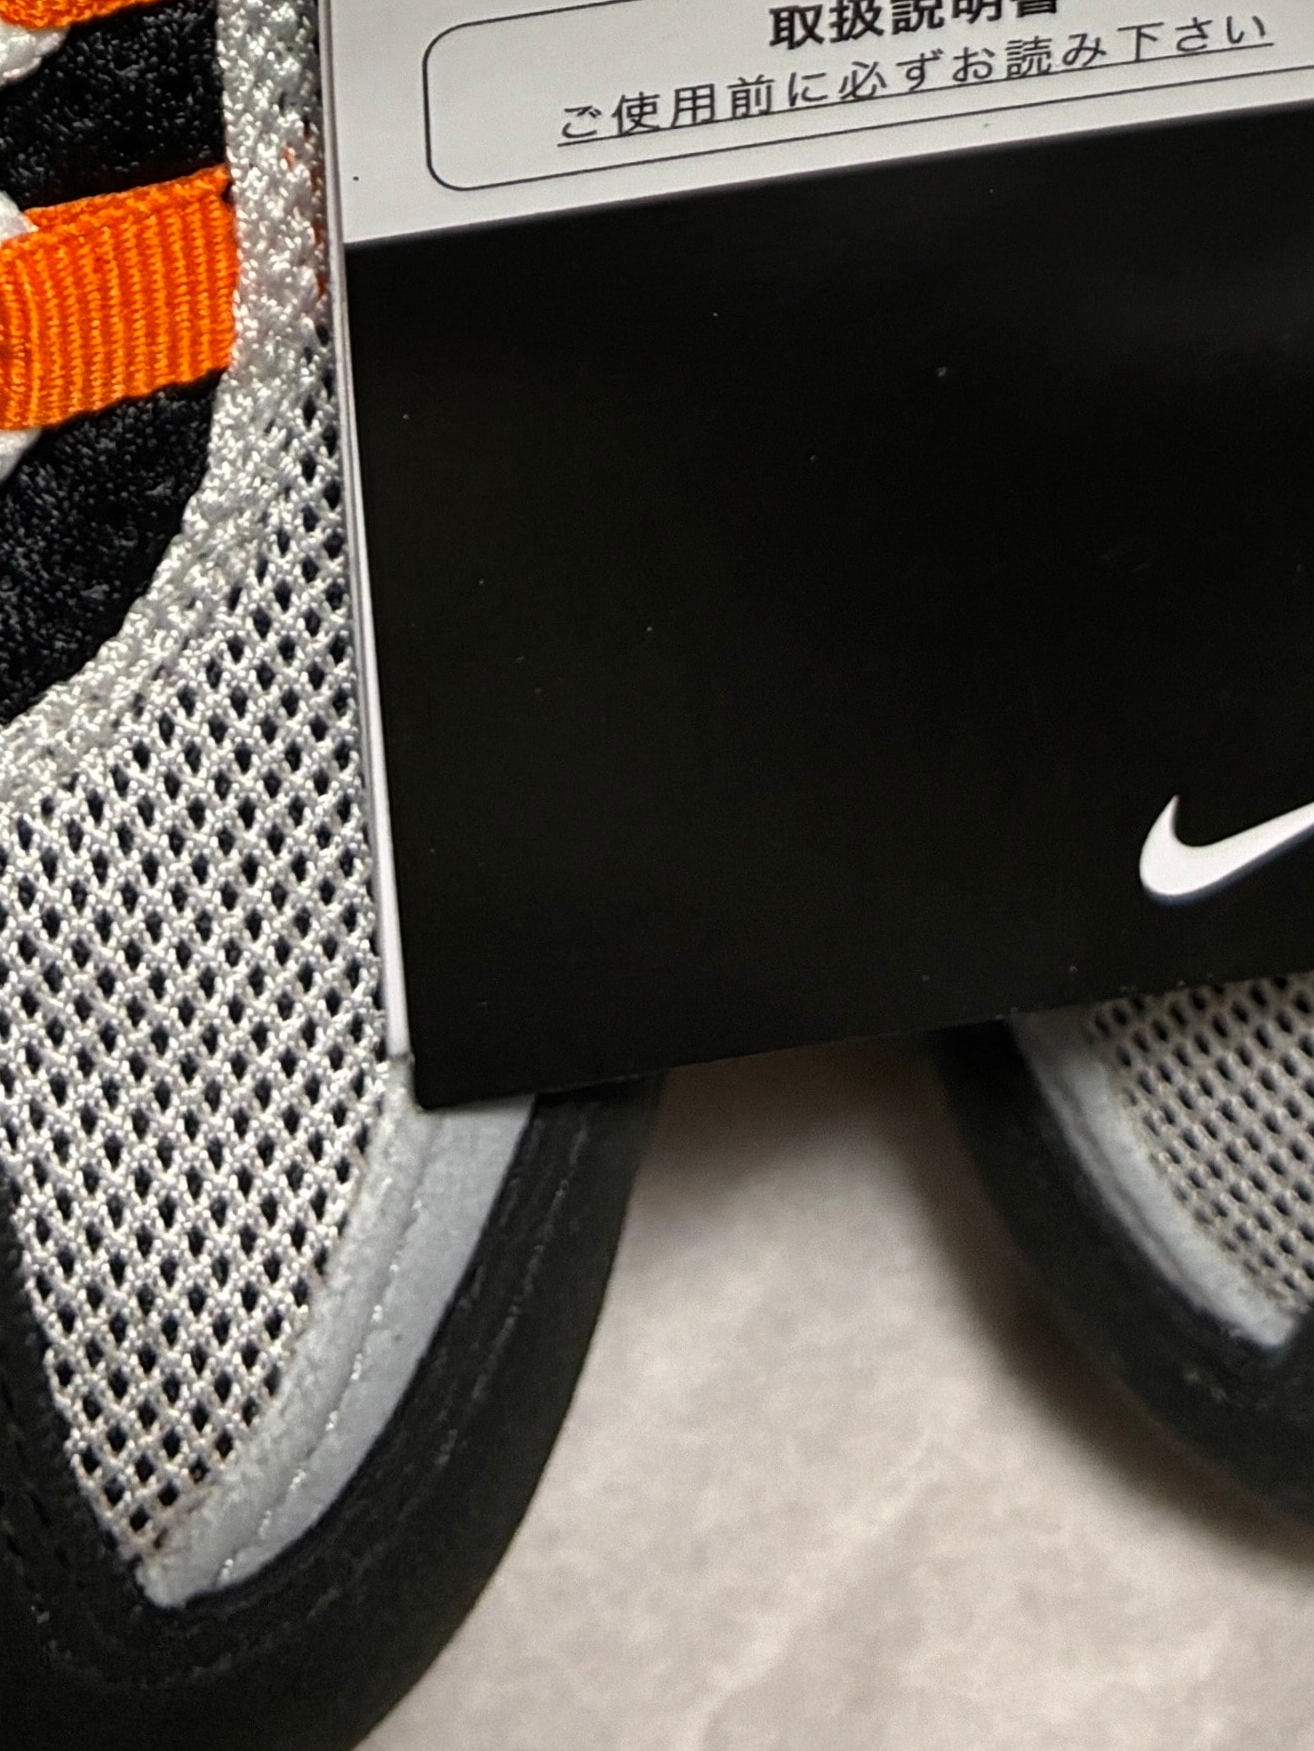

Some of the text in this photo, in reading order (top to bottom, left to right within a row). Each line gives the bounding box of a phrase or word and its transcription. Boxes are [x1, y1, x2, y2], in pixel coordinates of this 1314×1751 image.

[561, 16, 1266, 139] ご使用前に必ずお読み下さい
